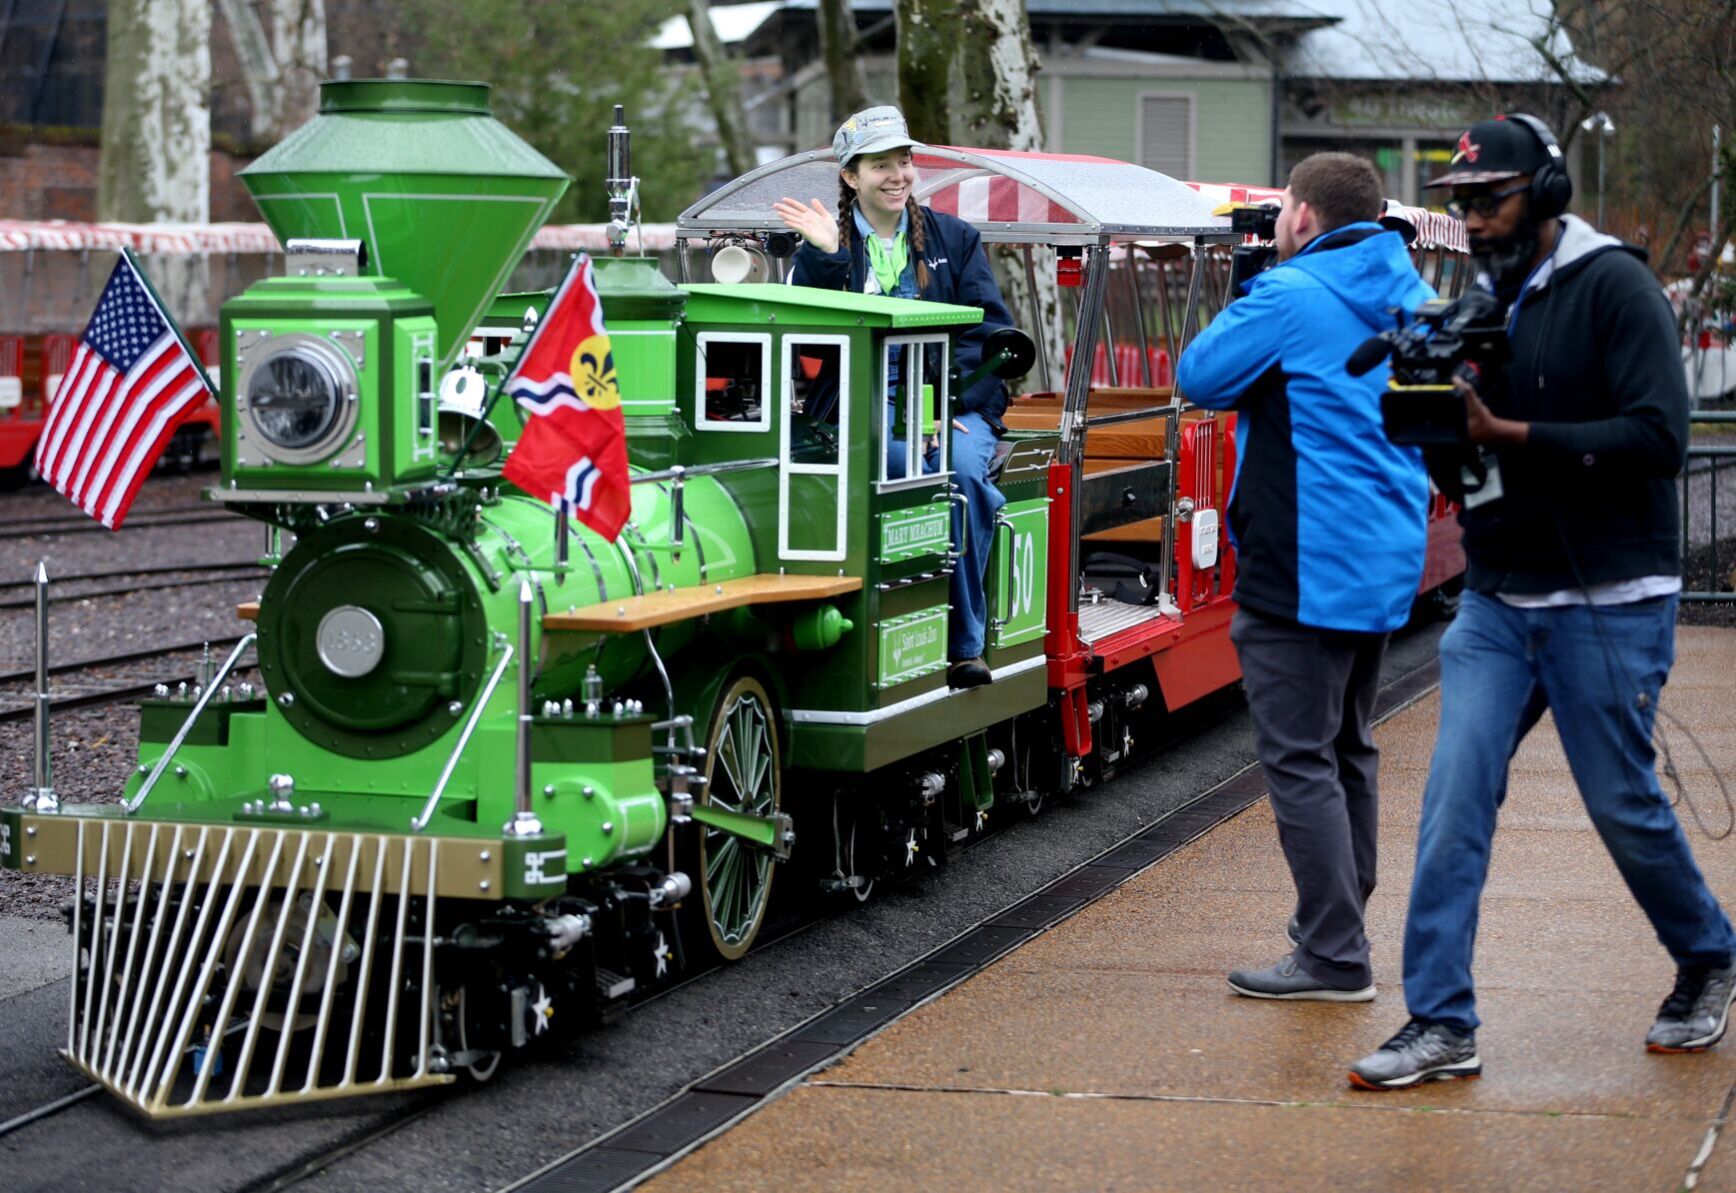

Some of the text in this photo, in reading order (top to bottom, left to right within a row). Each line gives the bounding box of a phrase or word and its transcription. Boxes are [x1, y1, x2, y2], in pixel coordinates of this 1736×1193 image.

[887, 526, 908, 547] MARY
[1012, 531, 1034, 617] 50
[902, 625, 937, 651] Saint Louis Zoo
